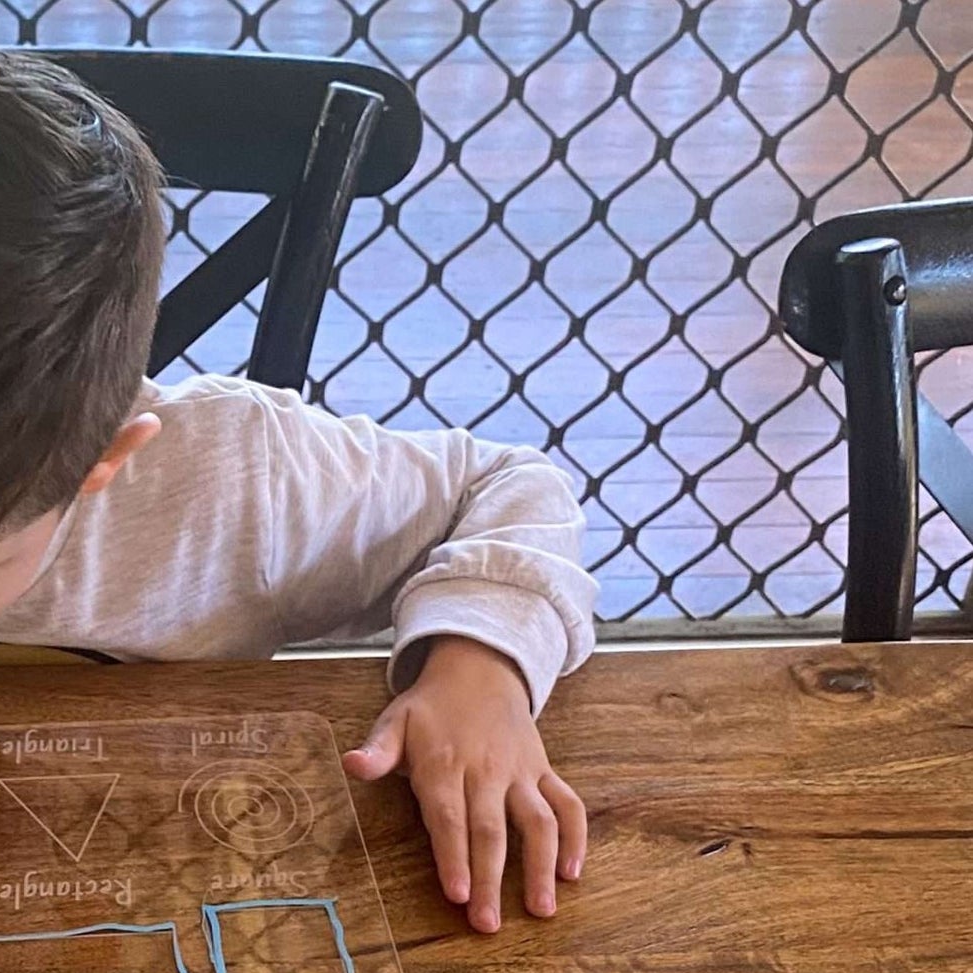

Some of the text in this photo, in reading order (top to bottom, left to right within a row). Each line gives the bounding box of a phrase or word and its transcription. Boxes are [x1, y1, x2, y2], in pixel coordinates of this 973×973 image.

[1, 729, 105, 764] Triangle
[191, 719, 269, 757] Spiral
[0, 870, 133, 910] Rectangle
[210, 861, 309, 897] Square
